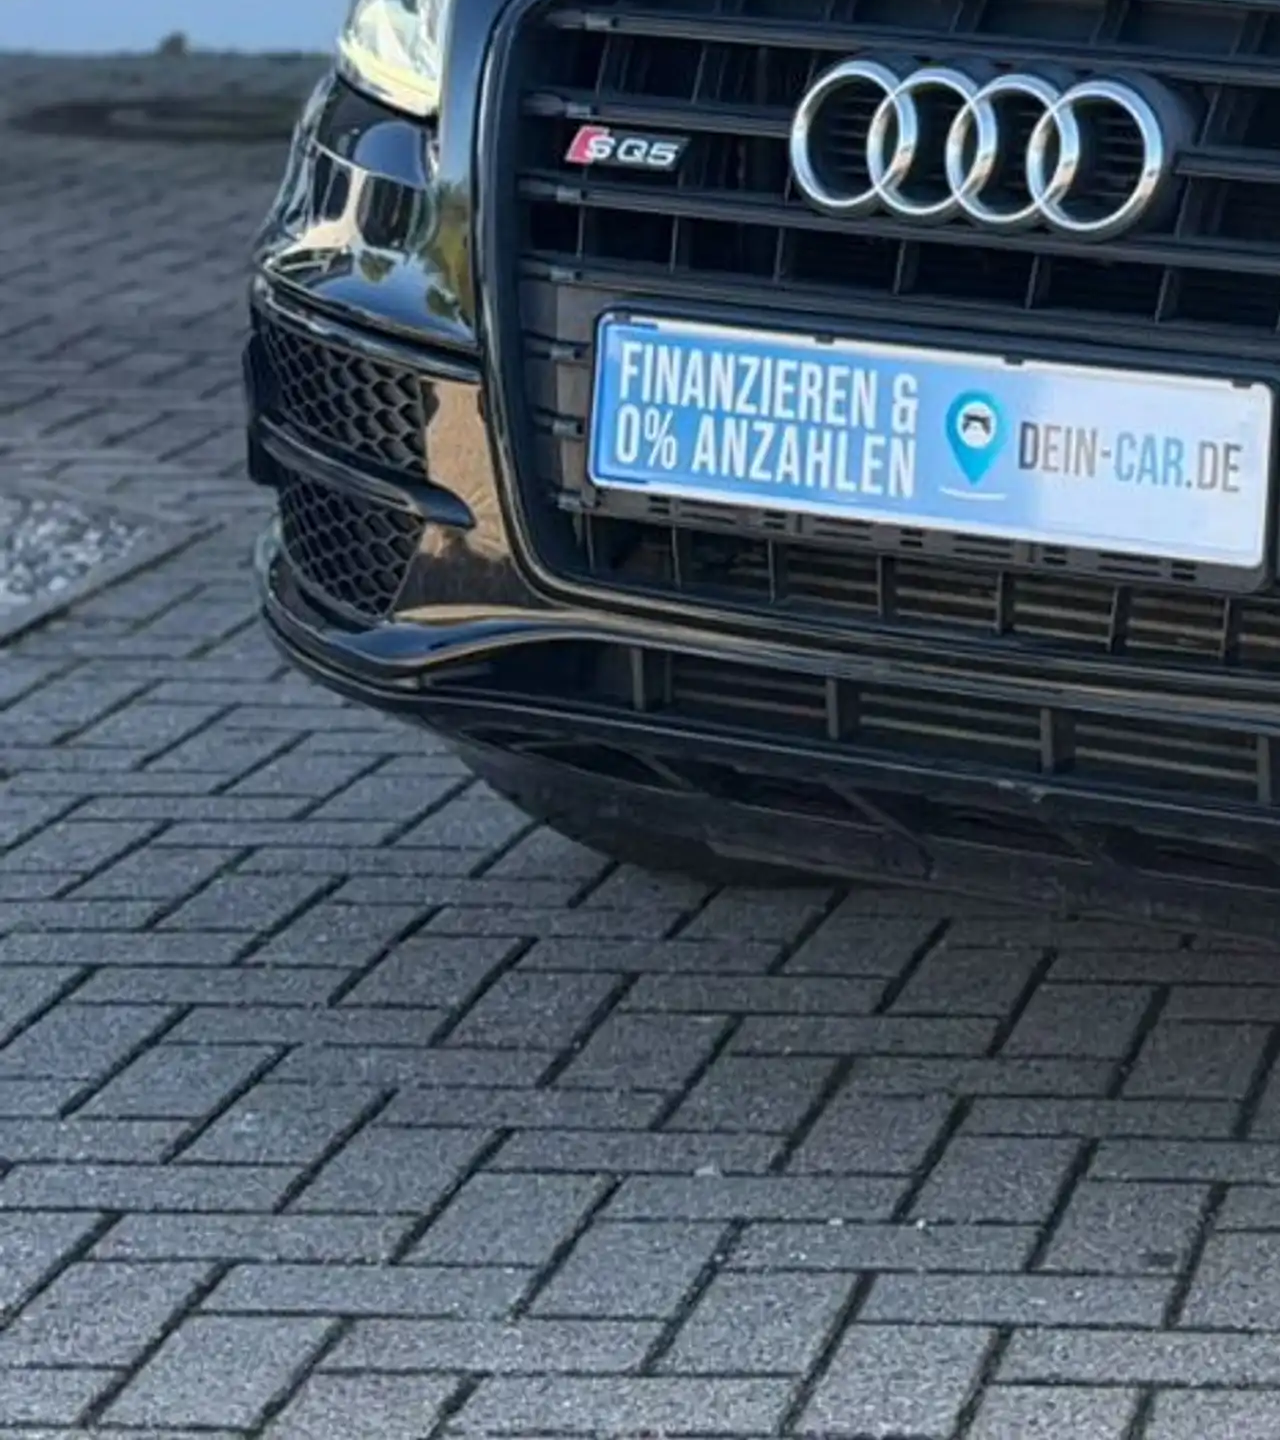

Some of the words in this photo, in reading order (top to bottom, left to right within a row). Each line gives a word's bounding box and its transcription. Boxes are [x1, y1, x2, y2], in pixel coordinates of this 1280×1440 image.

[619, 340, 876, 428] FINANZIEREN
[891, 373, 918, 434] &
[615, 406, 677, 471] 0%
[691, 417, 918, 500] ANZAHLEN
[1017, 420, 1244, 494] DEIN-CAR.DE
